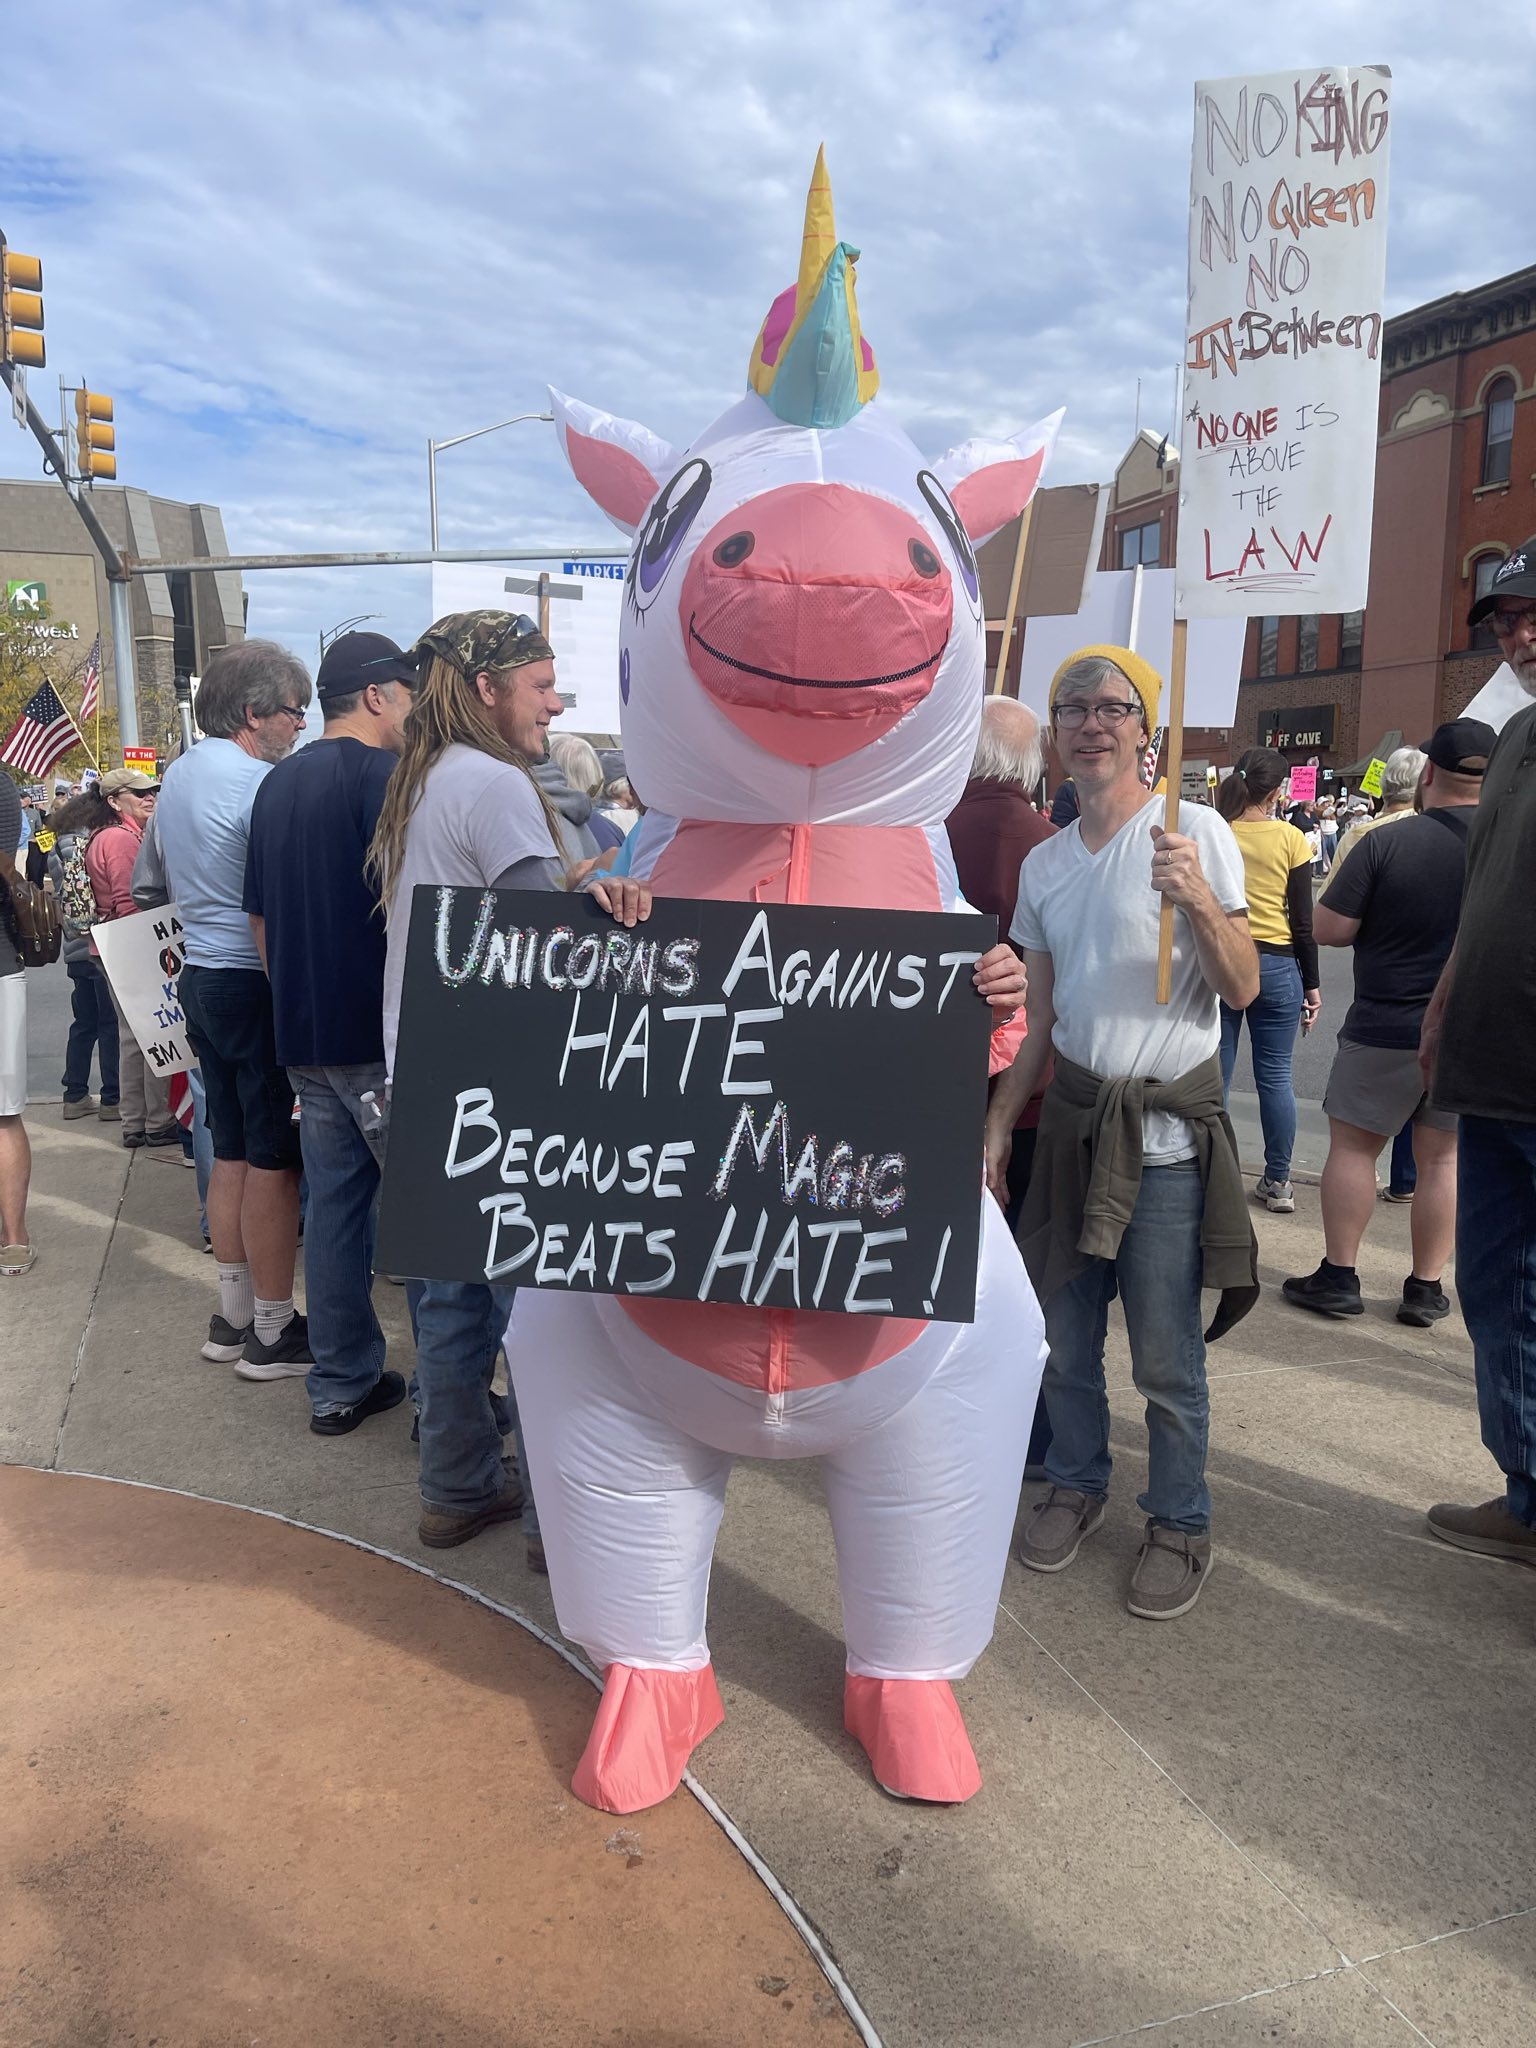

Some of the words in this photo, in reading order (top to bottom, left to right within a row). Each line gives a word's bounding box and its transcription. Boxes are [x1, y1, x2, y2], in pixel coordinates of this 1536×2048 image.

[1205, 85, 1288, 176] NO
[1294, 73, 1389, 166] KING
[1200, 181, 1262, 271] NO
[1246, 237, 1310, 310] NO
[1296, 402, 1340, 431] IS
[1229, 441, 1306, 478] ABOVE
[1232, 485, 1282, 517] THE
[572, 564, 627, 580] MARKET
[1204, 514, 1332, 580] LAW
[139, 751, 154, 759] THE
[1265, 733, 1290, 748] PUFF
[1295, 731, 1321, 746] CAVE
[435, 887, 701, 997] UNICORNS
[722, 909, 983, 1013] AGAINST
[559, 991, 784, 1098] HATE
[445, 1088, 696, 1199] BECAUSE
[708, 1099, 908, 1218] MAGIC
[479, 1191, 676, 1295] BEATS
